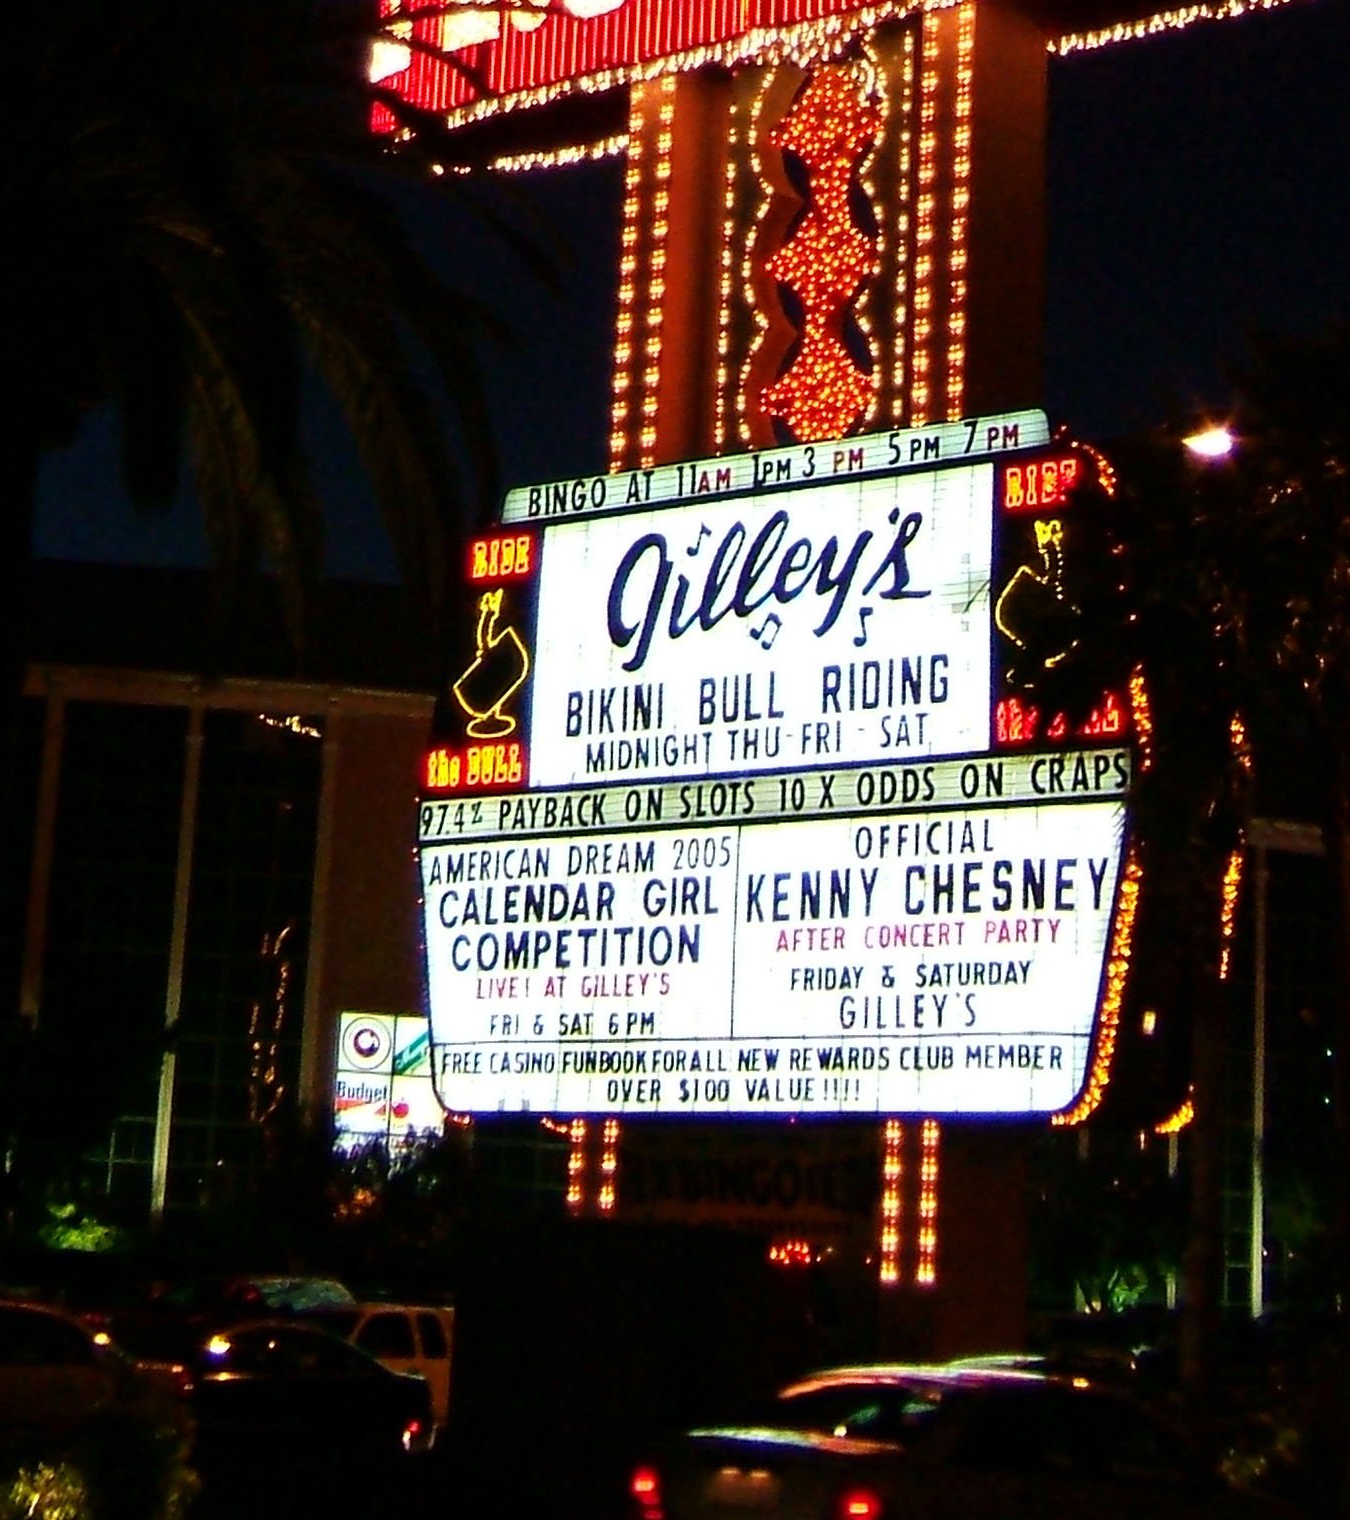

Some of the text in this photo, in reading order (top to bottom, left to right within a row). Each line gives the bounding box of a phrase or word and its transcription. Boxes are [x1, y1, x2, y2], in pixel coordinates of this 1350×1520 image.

[528, 477, 607, 518] BINGO
[626, 470, 655, 505] AT
[802, 446, 816, 478] 3
[832, 448, 864, 474] PM
[987, 424, 1019, 451] PM
[472, 536, 530, 579] RIDE
[606, 506, 932, 672] Gilley's
[566, 653, 949, 738] BIKINI BULL RIDING
[585, 732, 714, 774] MIDNIGHT
[880, 712, 928, 748] SAT
[427, 743, 522, 788] the BULL
[499, 792, 607, 831] PAYBACK
[624, 787, 663, 823] ON
[679, 780, 756, 819] SLOTS
[779, 778, 806, 813] 10
[818, 774, 836, 810] X
[856, 765, 936, 807] ODDS
[960, 761, 1003, 799] ON
[1030, 752, 1130, 795] CRAPS
[428, 835, 733, 888] AMERICAN DREAM 2005
[855, 819, 994, 860] OFFICIAL
[439, 875, 719, 929] CALENDAR GIRL
[746, 857, 1109, 923] KENNY CHESNEY
[451, 923, 701, 972] COMPETITION
[776, 918, 1063, 953] AFTER CONCERT PARTY
[476, 972, 671, 999] LIVE! AT GILLEY'S
[790, 965, 865, 992] FRIDAY
[915, 960, 1032, 989] SATURDAY
[489, 1014, 519, 1036] FRI
[558, 1012, 594, 1036] SAT
[839, 991, 978, 1030] GILLEY'S
[441, 1051, 483, 1075] FREE
[489, 1051, 555, 1074] CASINO
[561, 1049, 648, 1075] FUNBOOK
[737, 1047, 780, 1072] NEW
[789, 1045, 891, 1072] REWARDS
[899, 1045, 954, 1071] CLUB
[965, 1043, 1064, 1071] MEMBER
[336, 1080, 388, 1103] Budget
[607, 1078, 662, 1103] OVER
[679, 1077, 730, 1103] $100
